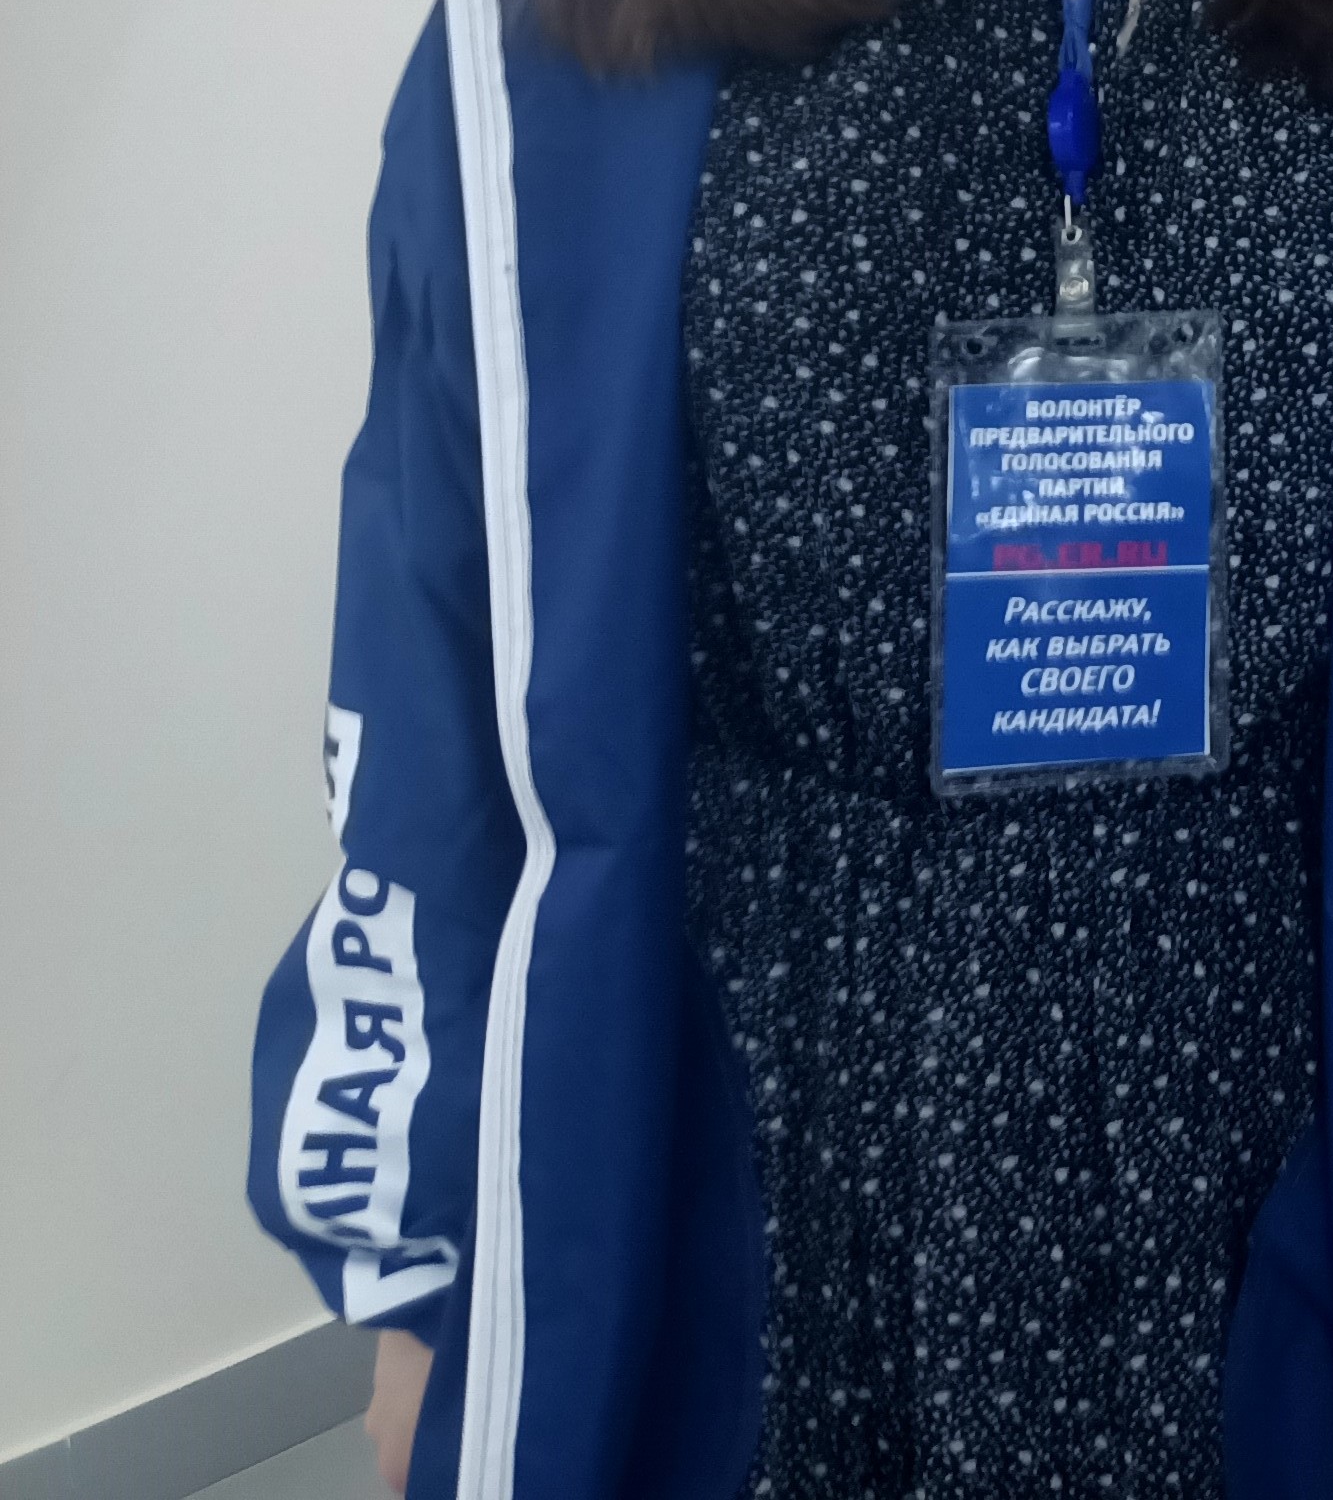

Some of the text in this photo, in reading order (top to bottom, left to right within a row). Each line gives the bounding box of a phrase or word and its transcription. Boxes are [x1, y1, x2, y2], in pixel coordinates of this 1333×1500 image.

[1025, 395, 1142, 419] ВОЛОНТЁР
[969, 423, 1195, 448] ПРЕДВАРИТЕЛЬНОГО
[1001, 449, 1163, 471] ГОЛОСОВАНИЯ
[1038, 476, 1126, 498] ПАРТИИ
[986, 633, 1171, 662] КАК ВЫБРАТЬ
[1020, 664, 1135, 696] СВОЕГО
[991, 699, 1162, 735] КАНДИДАТА!
